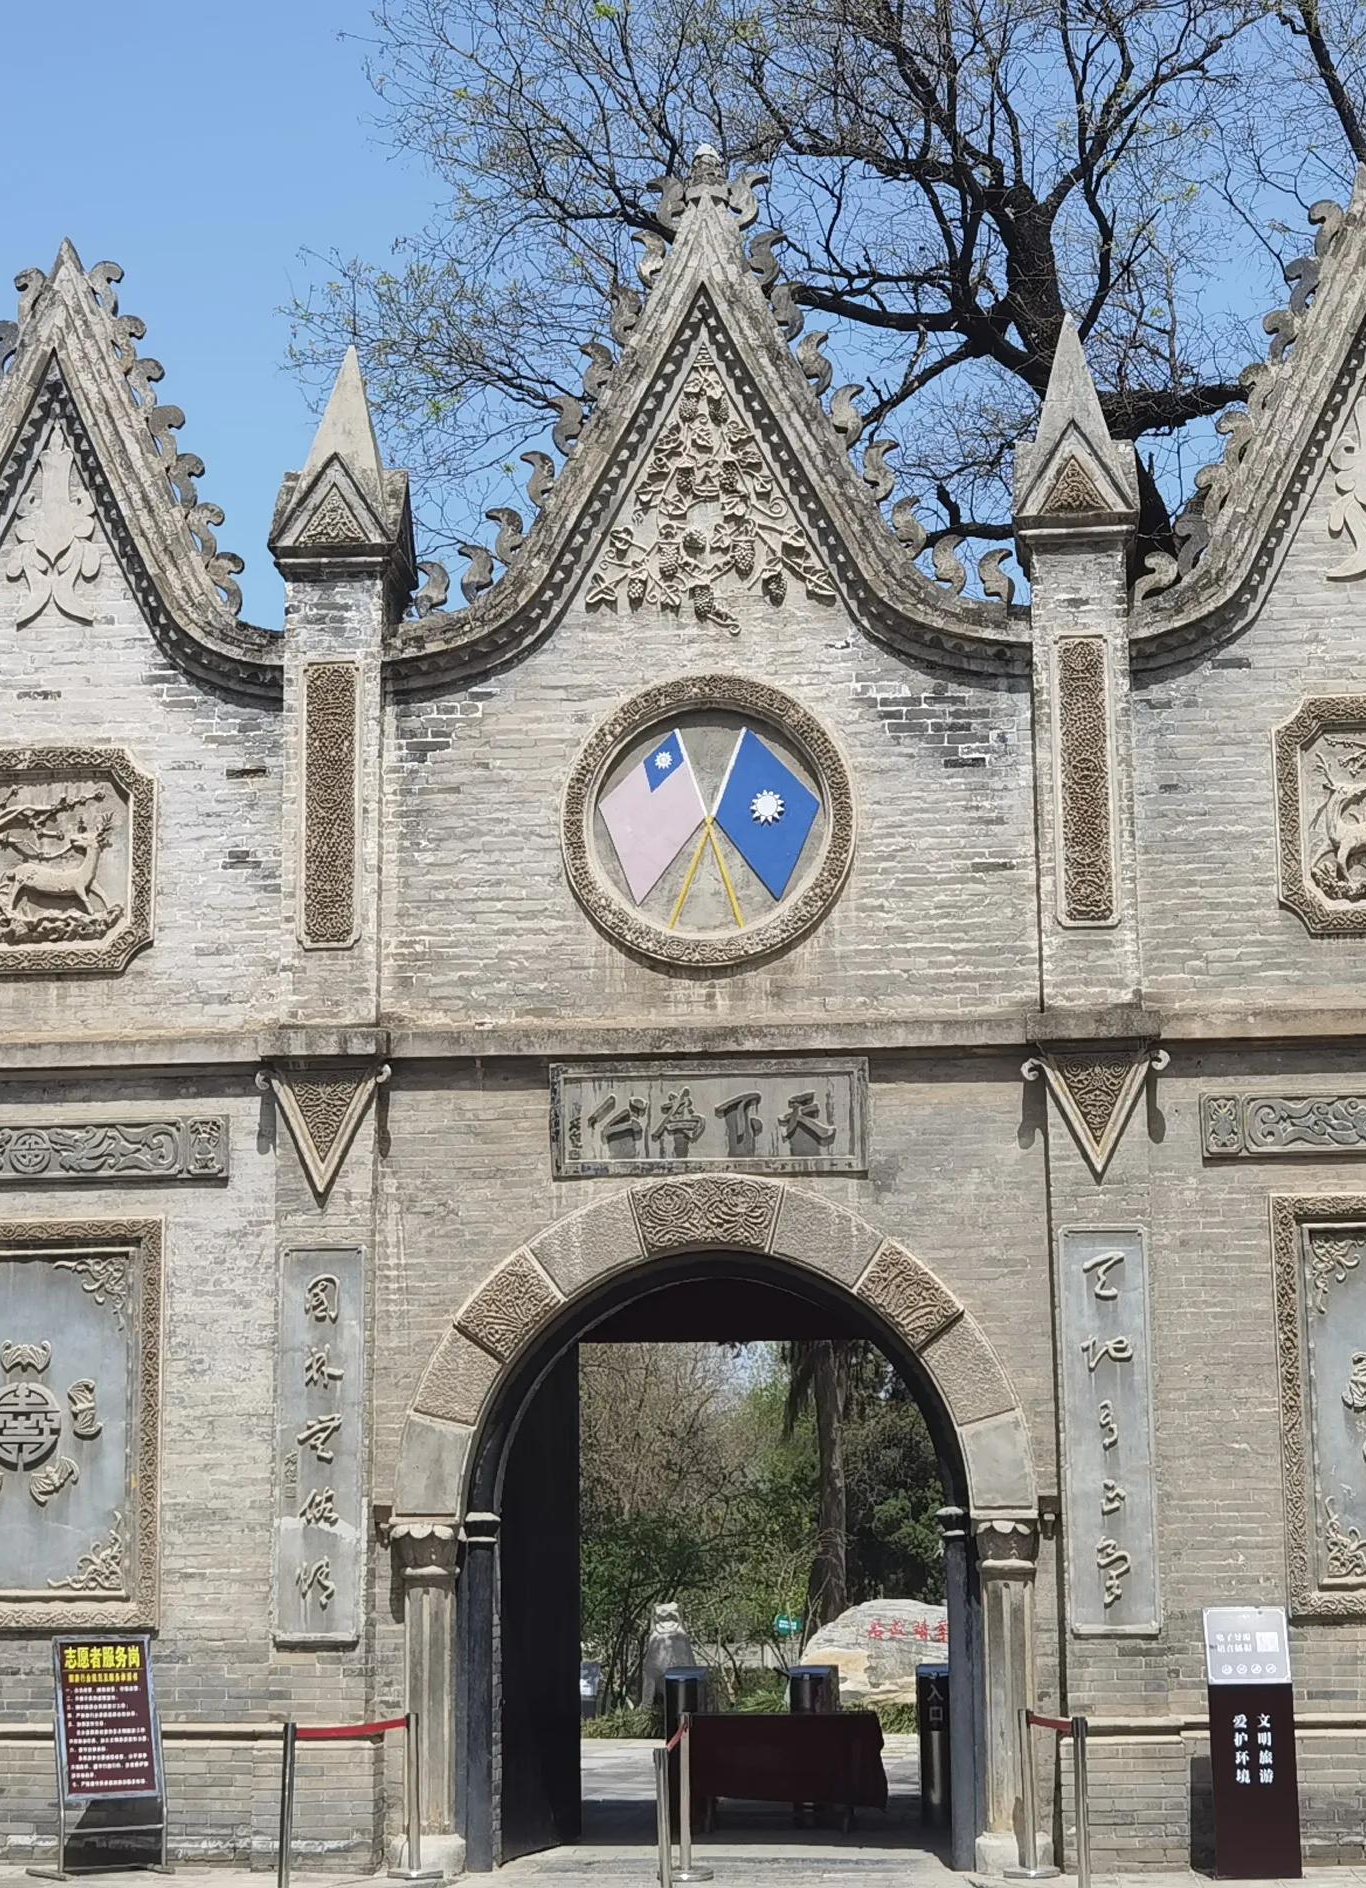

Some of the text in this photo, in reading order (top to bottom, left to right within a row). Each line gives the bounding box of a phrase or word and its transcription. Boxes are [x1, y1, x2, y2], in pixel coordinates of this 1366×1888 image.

[63, 1645, 141, 1669] 志愿者服务岗
[927, 1683, 944, 1722] 入口
[1232, 1713, 1251, 1784] 爱护环境
[1256, 1713, 1274, 1784] 文明旅游
